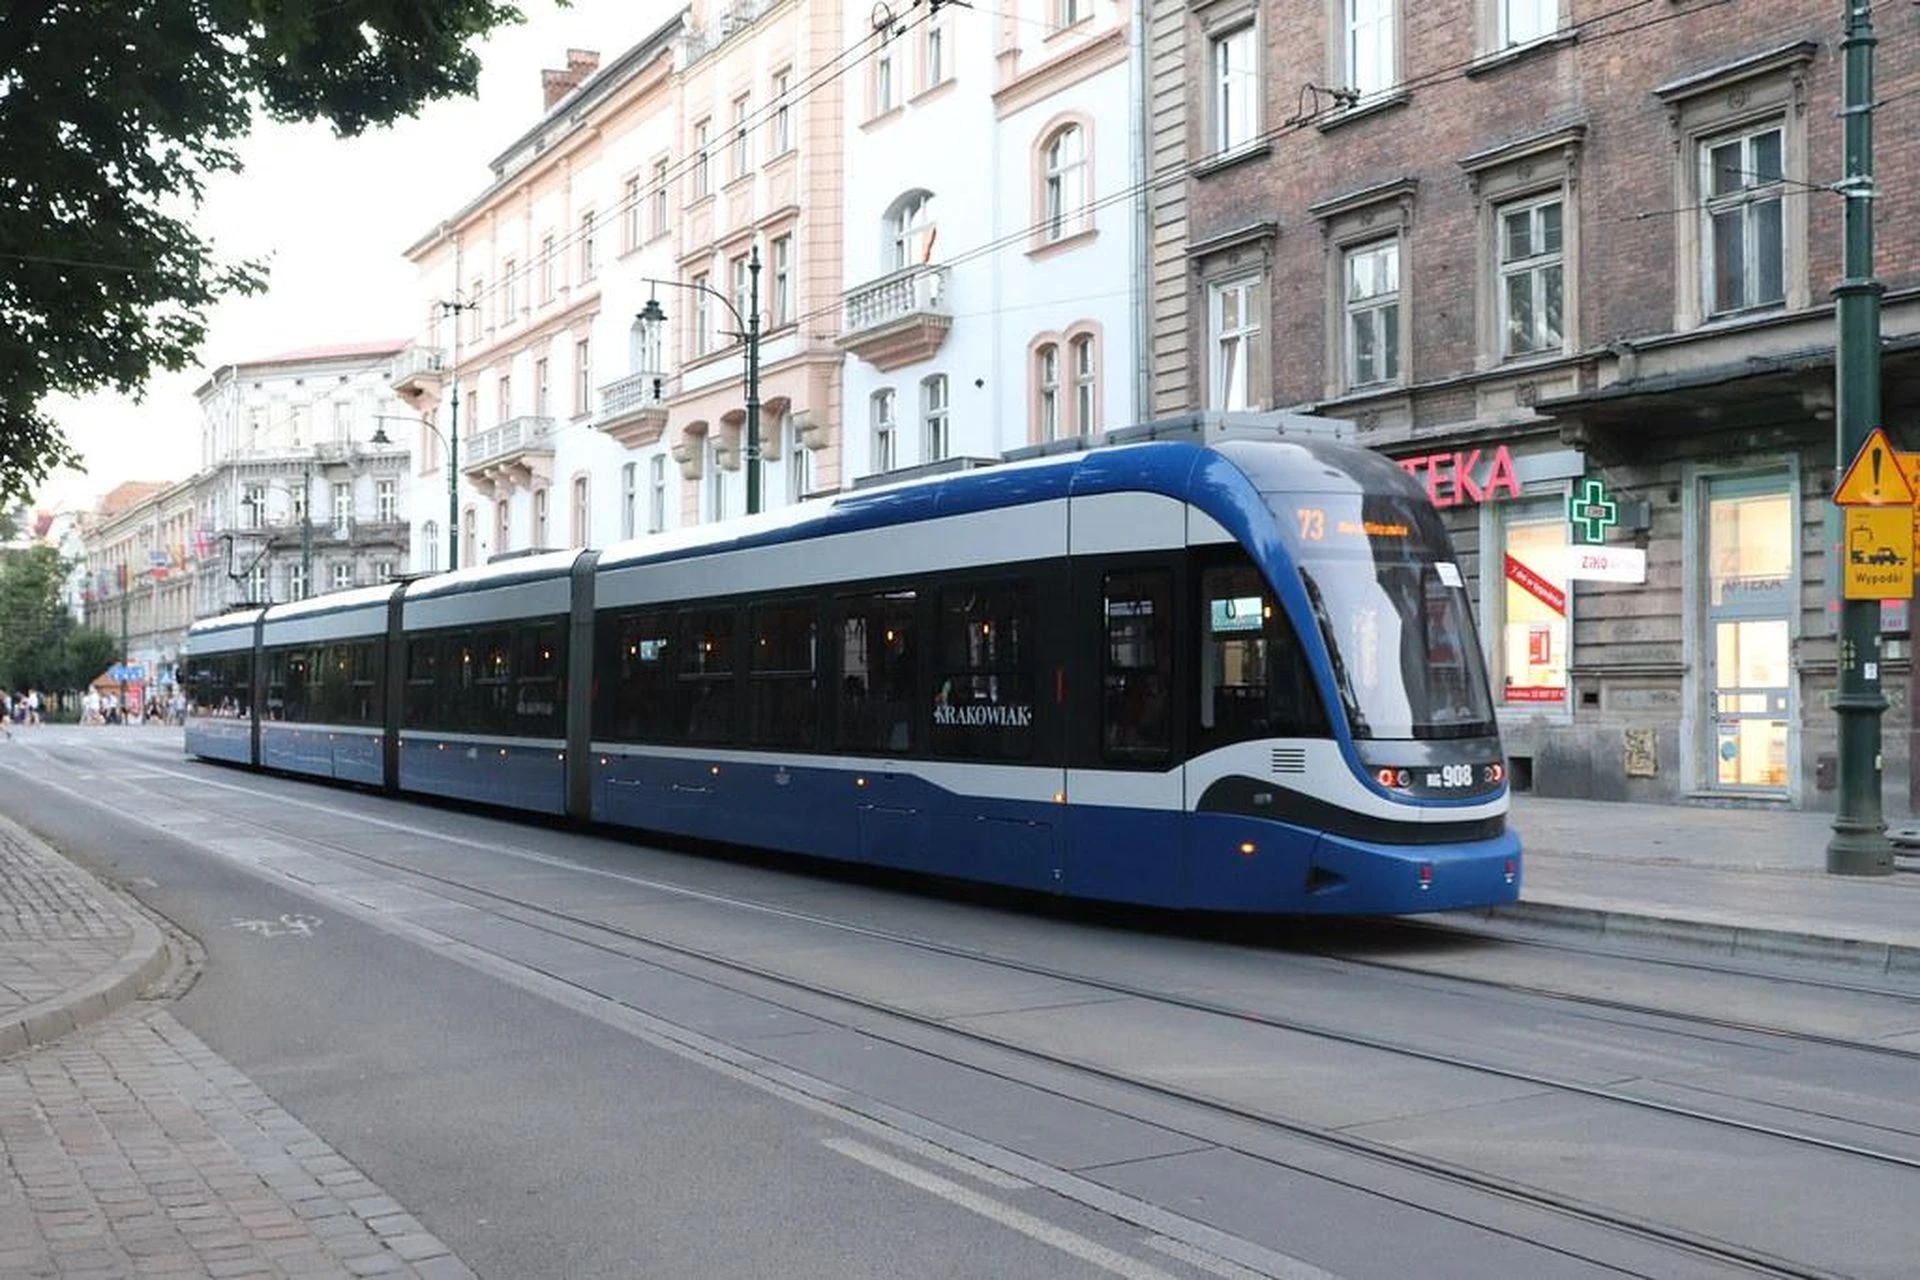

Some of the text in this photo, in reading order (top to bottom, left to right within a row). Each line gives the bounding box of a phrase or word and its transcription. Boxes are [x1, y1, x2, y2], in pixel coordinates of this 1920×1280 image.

[1297, 508, 1325, 540] 73
[936, 705, 1030, 726] KRAKOWIAK
[1442, 764, 1473, 787] 908
